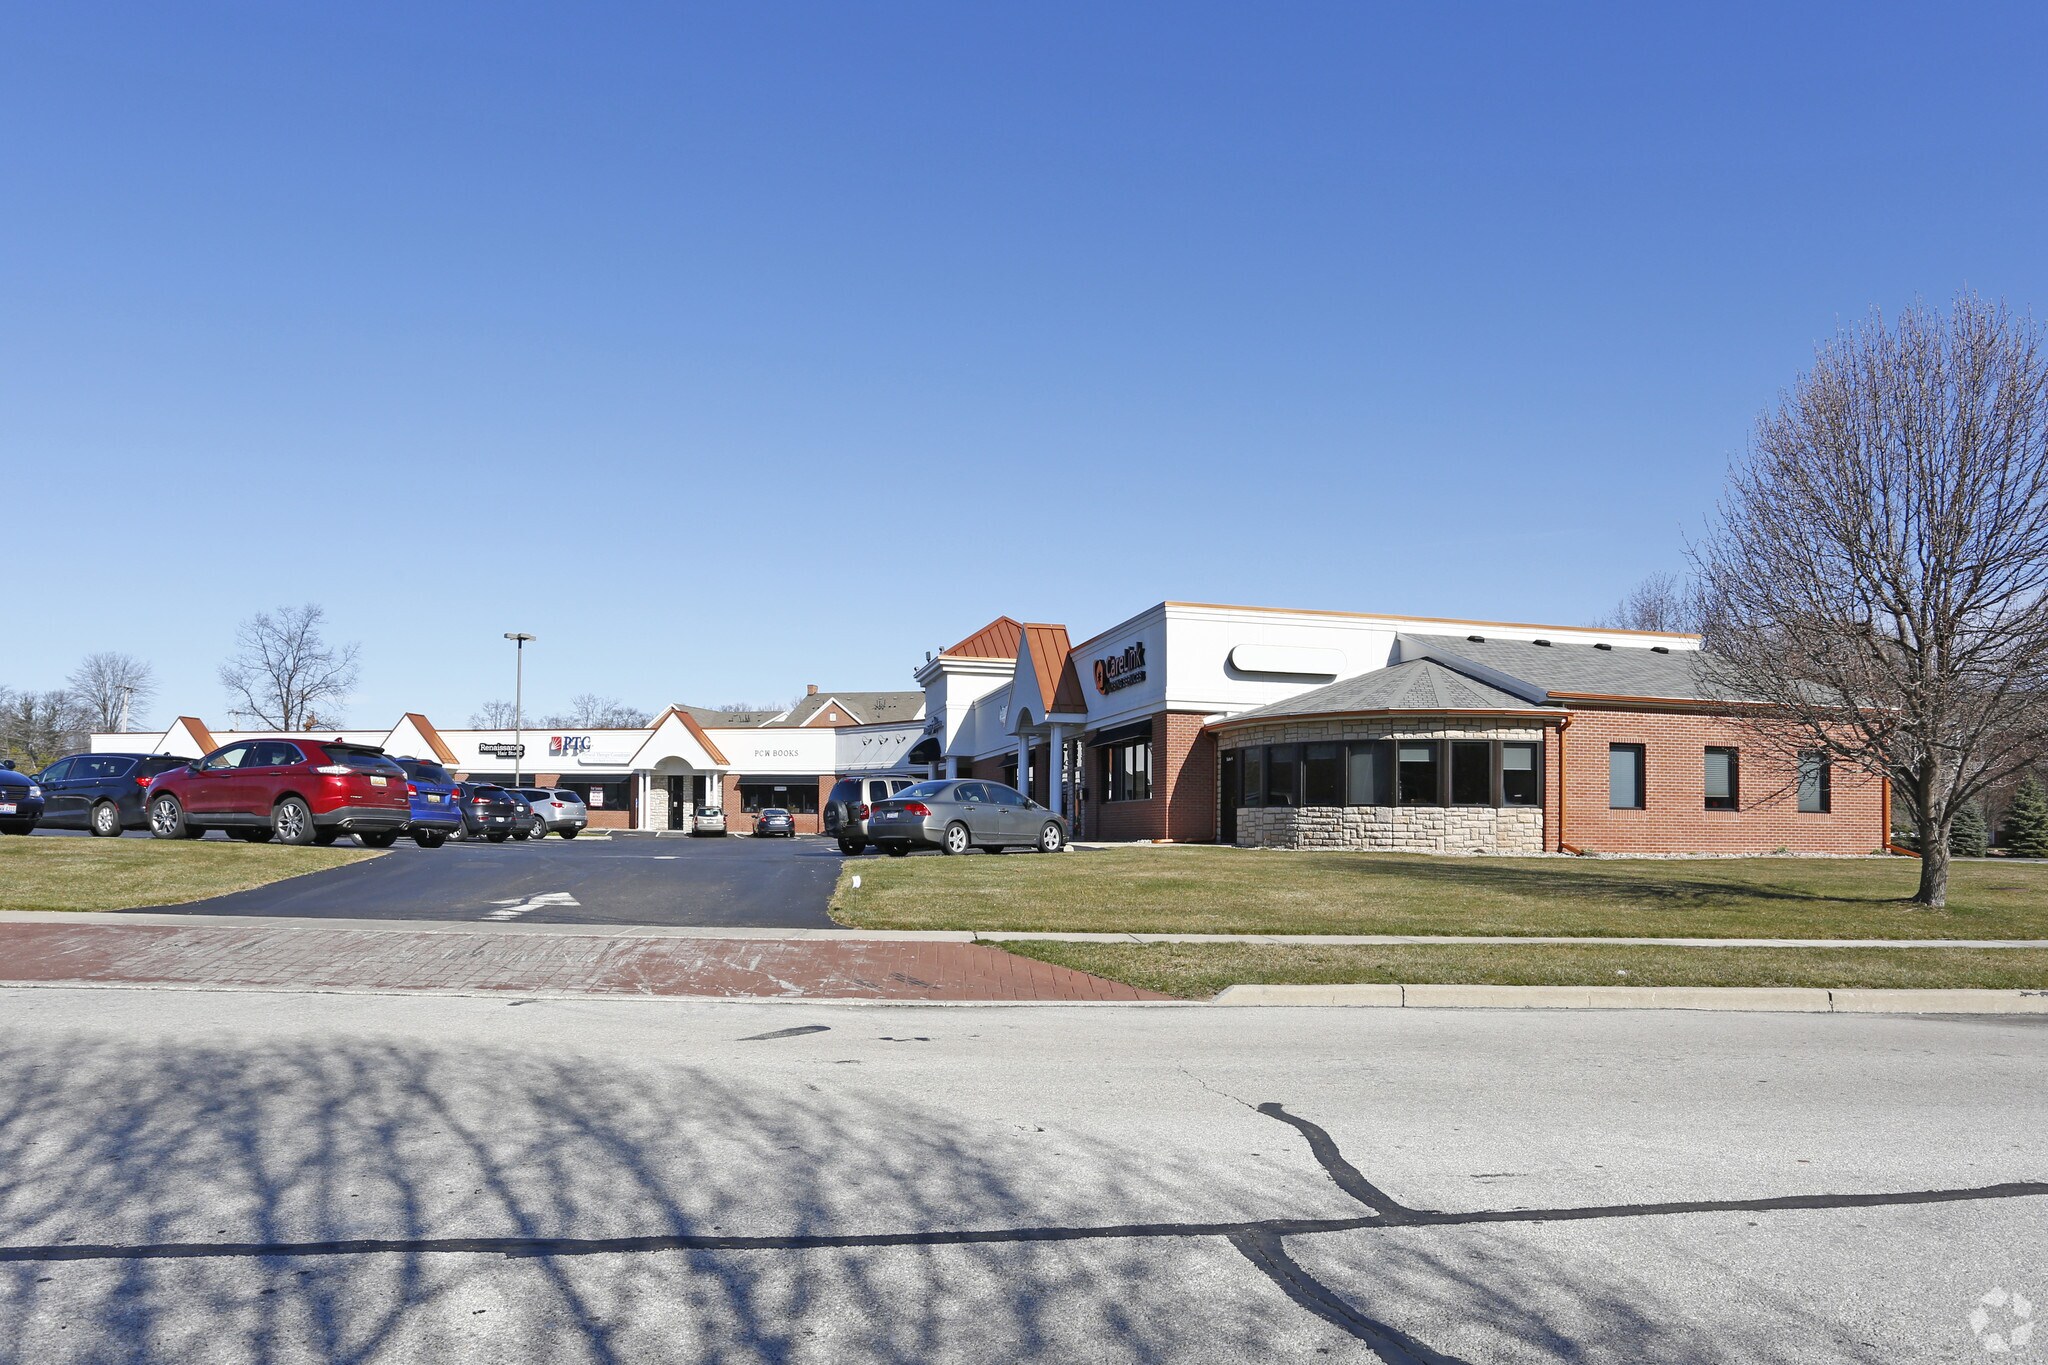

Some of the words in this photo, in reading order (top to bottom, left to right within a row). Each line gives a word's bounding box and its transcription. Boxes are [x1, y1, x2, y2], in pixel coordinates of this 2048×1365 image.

[1106, 642, 1145, 679] CareLink
[563, 736, 591, 750] PTC
[772, 749, 799, 757] BOOKS
